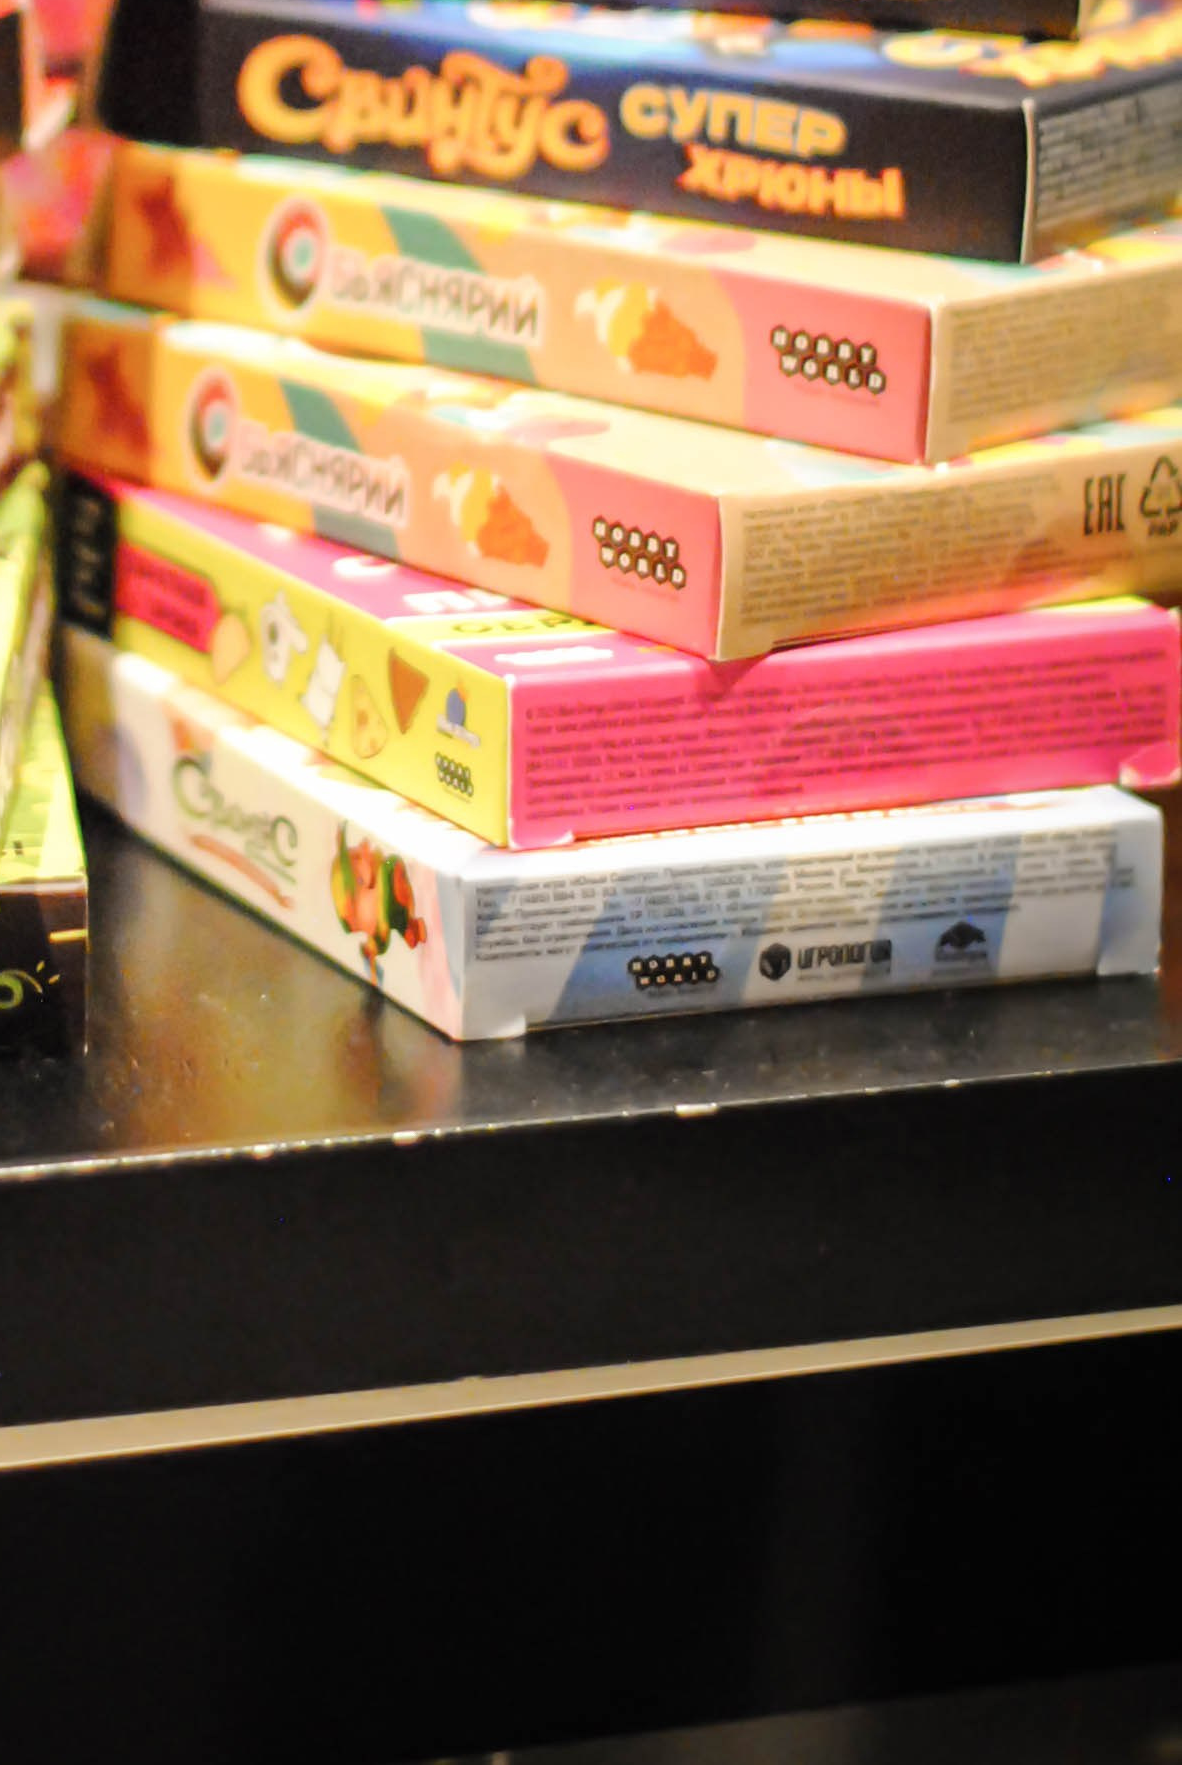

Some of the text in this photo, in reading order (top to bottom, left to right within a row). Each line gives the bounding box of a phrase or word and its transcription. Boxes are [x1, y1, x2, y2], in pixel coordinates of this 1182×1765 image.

[620, 84, 846, 157] СУПЕР
[677, 145, 905, 220] ХРЮНЫ
[772, 326, 876, 366] HOBBY
[780, 352, 885, 393] WORLD
[593, 516, 679, 563] HOBBY
[599, 544, 686, 590] WORLD
